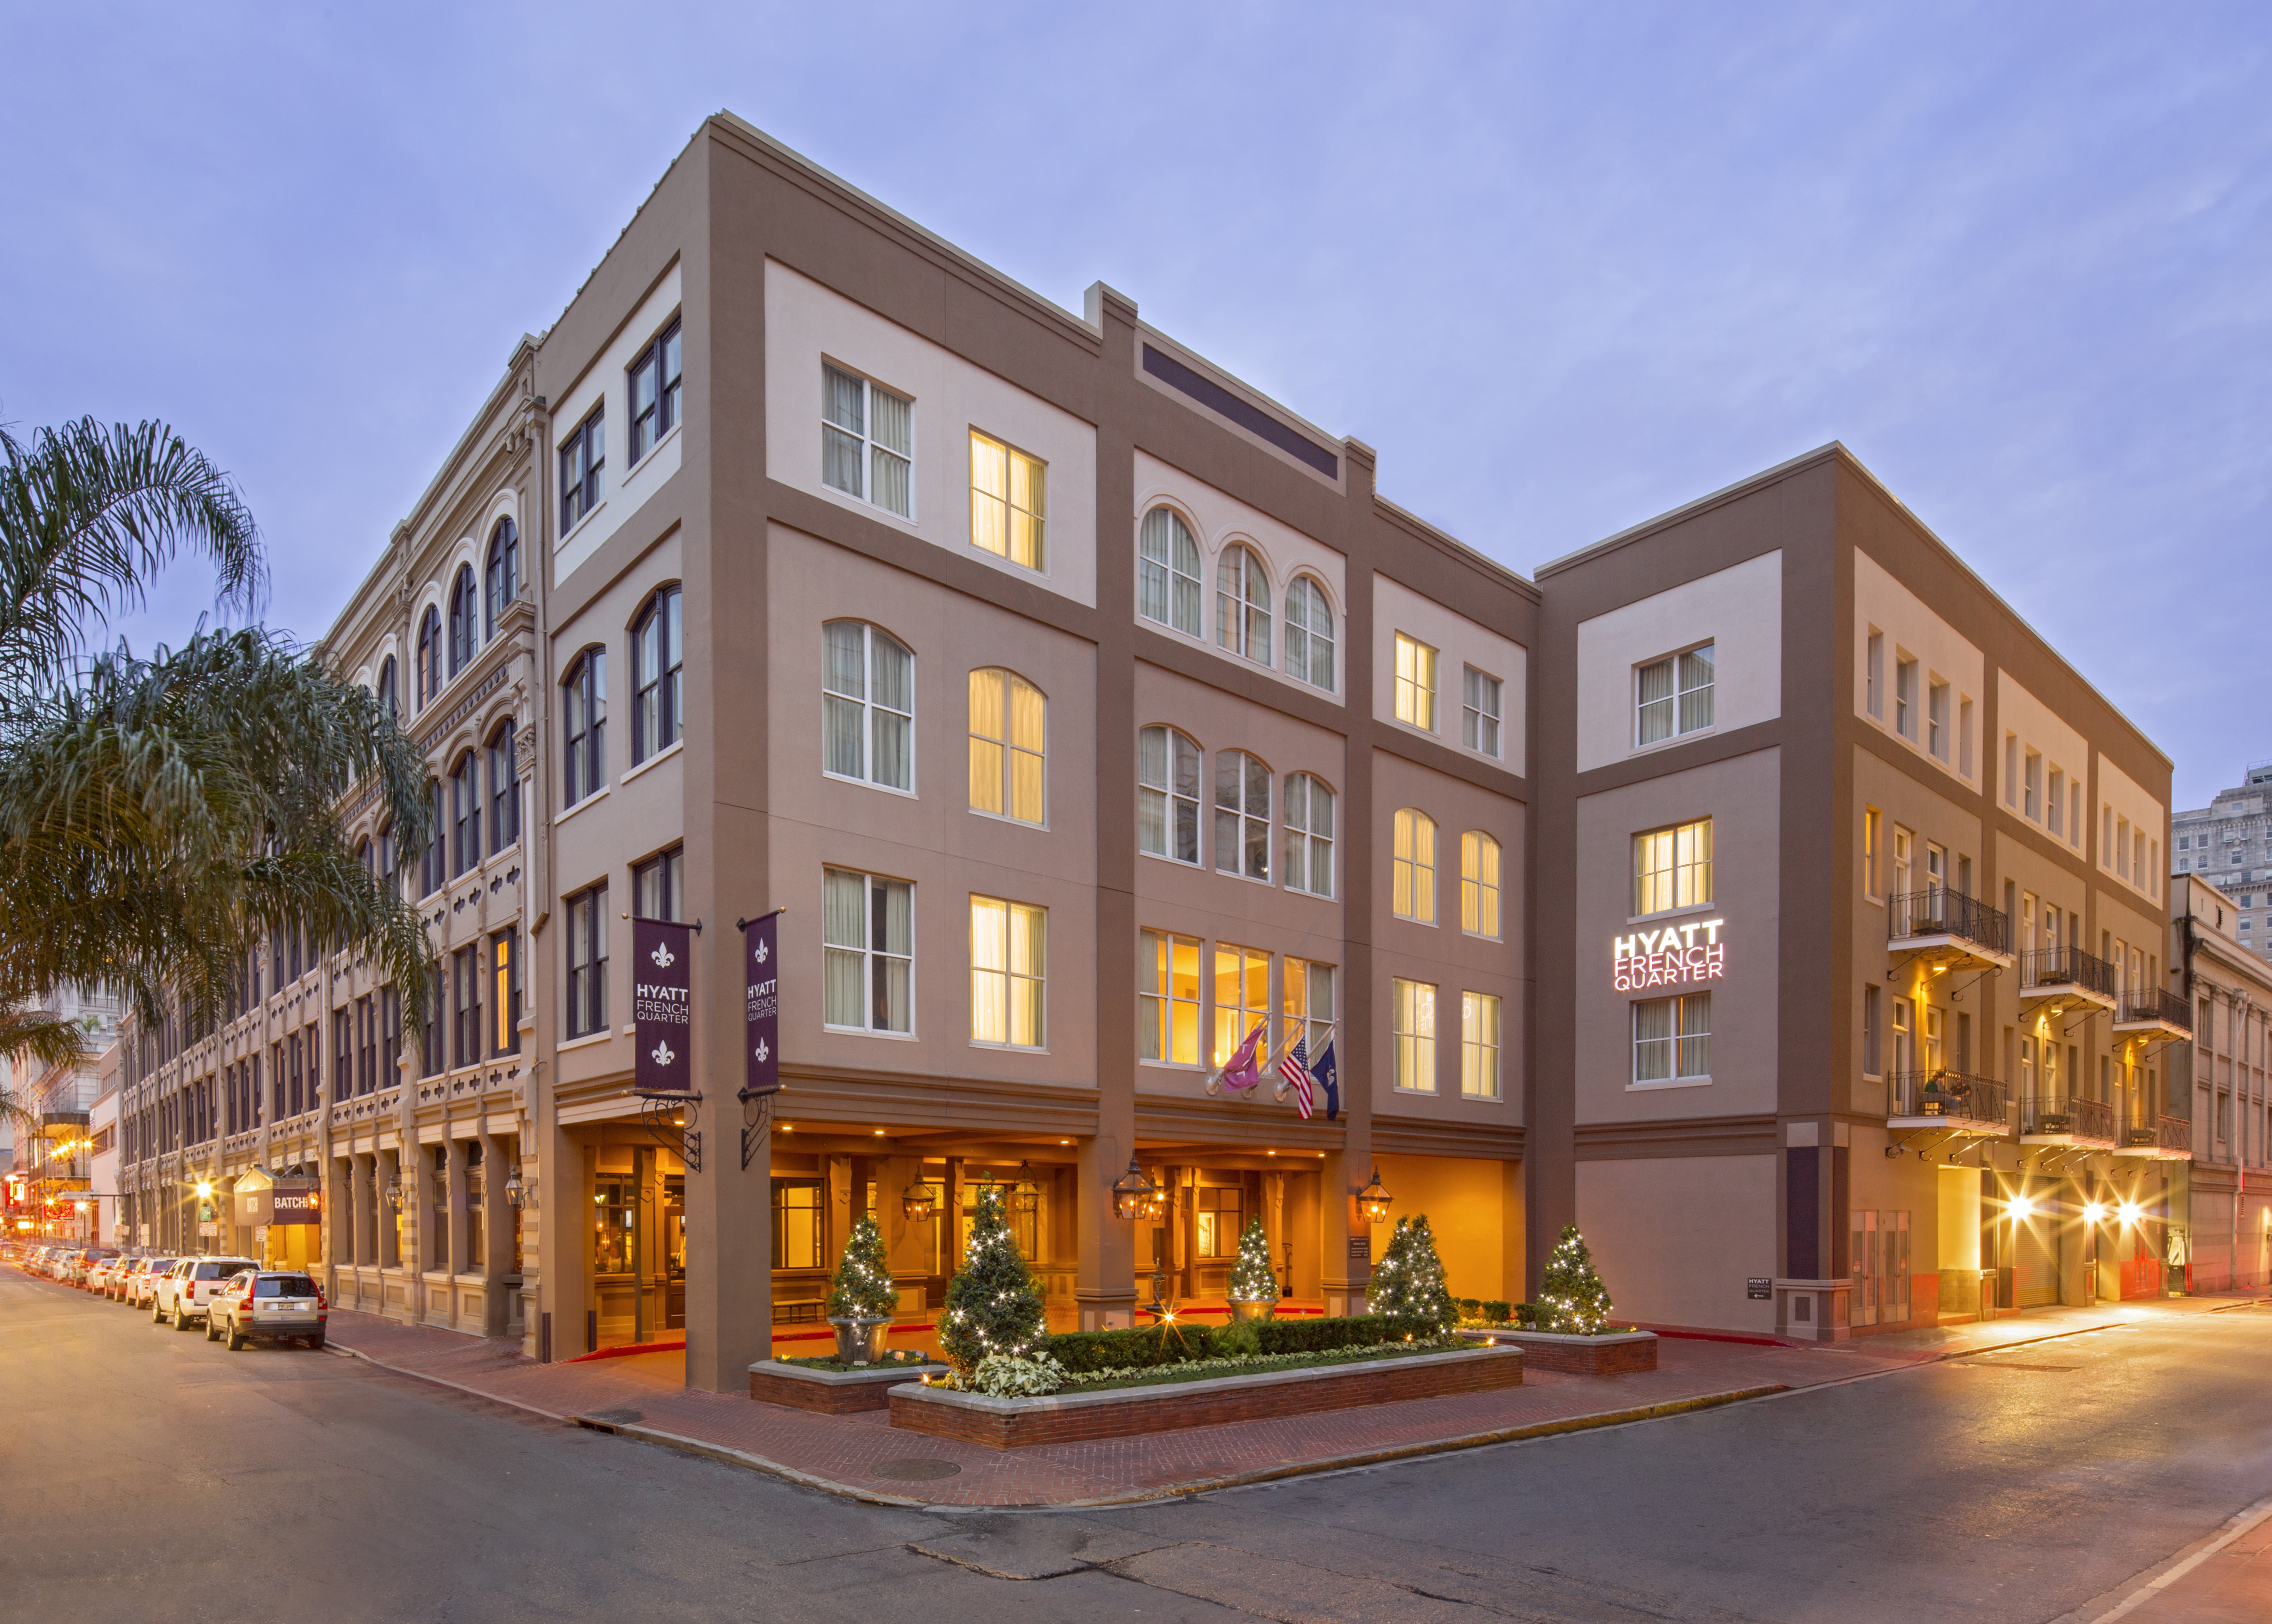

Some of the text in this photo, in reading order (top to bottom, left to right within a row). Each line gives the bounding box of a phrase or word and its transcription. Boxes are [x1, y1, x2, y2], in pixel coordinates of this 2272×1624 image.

[1615, 919, 1724, 959] HYATT
[1615, 944, 1724, 977] FRENCH
[1615, 962, 1723, 991] QUARTER
[637, 984, 688, 1002] HYATT
[748, 979, 776, 999] HYATT
[637, 999, 688, 1015] FRENCH
[748, 995, 777, 1013] FRENCH
[637, 1012, 688, 1024] QUARTER
[748, 1006, 777, 1022] QUARTER
[274, 1196, 305, 1208] BATCH
